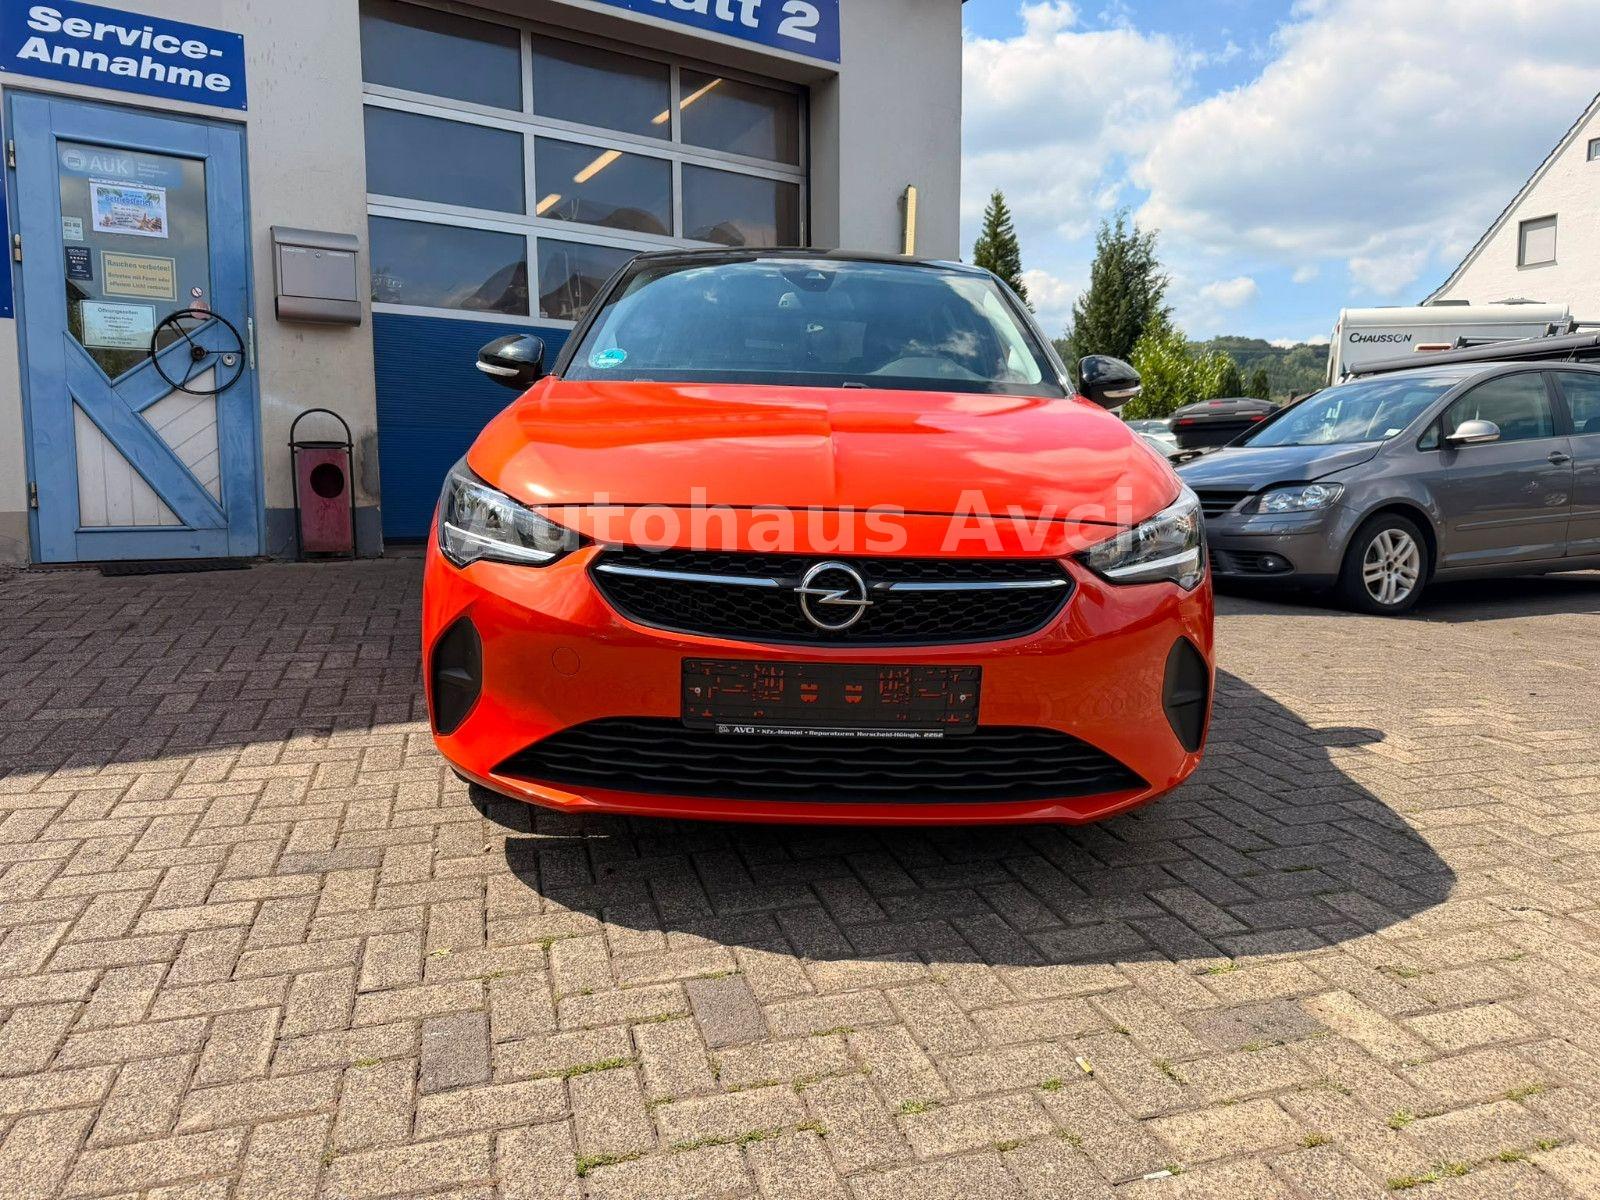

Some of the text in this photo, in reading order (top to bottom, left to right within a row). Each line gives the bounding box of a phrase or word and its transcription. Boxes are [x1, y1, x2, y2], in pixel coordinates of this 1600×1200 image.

[27, 6, 222, 58] Service-
[777, 0, 820, 43] 2
[16, 36, 231, 92] Annahme
[107, 260, 137, 269] Rauchen
[1349, 332, 1412, 343] CHAUSSON
[733, 726, 755, 734] AVCI
